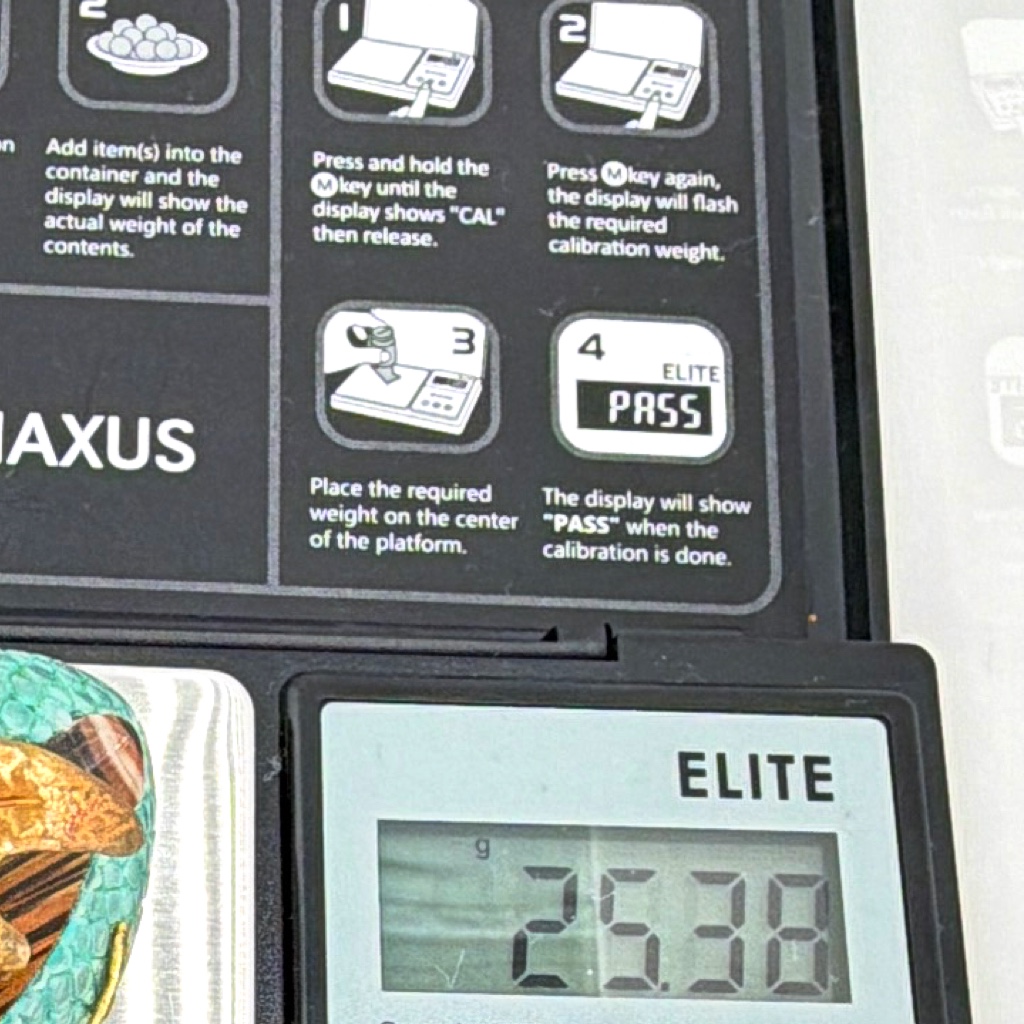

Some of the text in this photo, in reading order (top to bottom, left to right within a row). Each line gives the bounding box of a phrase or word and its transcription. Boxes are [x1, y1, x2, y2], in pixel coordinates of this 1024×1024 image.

[558, 14, 587, 44] 2
[46, 138, 242, 165] Add item(s) into the
[313, 151, 490, 177] Press and hold the
[45, 164, 220, 188] container and the
[339, 177, 373, 198] key
[376, 178, 421, 197] until
[425, 180, 457, 200] the
[547, 162, 598, 182] Press
[626, 163, 660, 186] key
[664, 169, 721, 190] again,
[44, 188, 249, 214] display will show the
[312, 202, 506, 226] display shows "CAL"
[547, 188, 739, 214] the display will flash
[43, 212, 241, 239] actual weight of the
[313, 227, 439, 247] then release.
[548, 213, 668, 236] the required
[42, 237, 135, 258] contents.
[548, 237, 726, 265] calibration weight.
[451, 327, 477, 356] 3
[577, 333, 606, 361] 4
[662, 363, 720, 383] ELITE
[608, 390, 702, 429] PASS
[310, 477, 492, 505] Place the required
[542, 487, 751, 515] The display will show
[309, 504, 519, 530] weight on the center
[543, 513, 719, 539] "PASS" when the
[309, 531, 467, 556] of the platform.
[542, 541, 733, 568] calibration is done.
[677, 750, 835, 802] ELITE
[475, 836, 490, 859] g
[511, 865, 830, 996] 25.38
